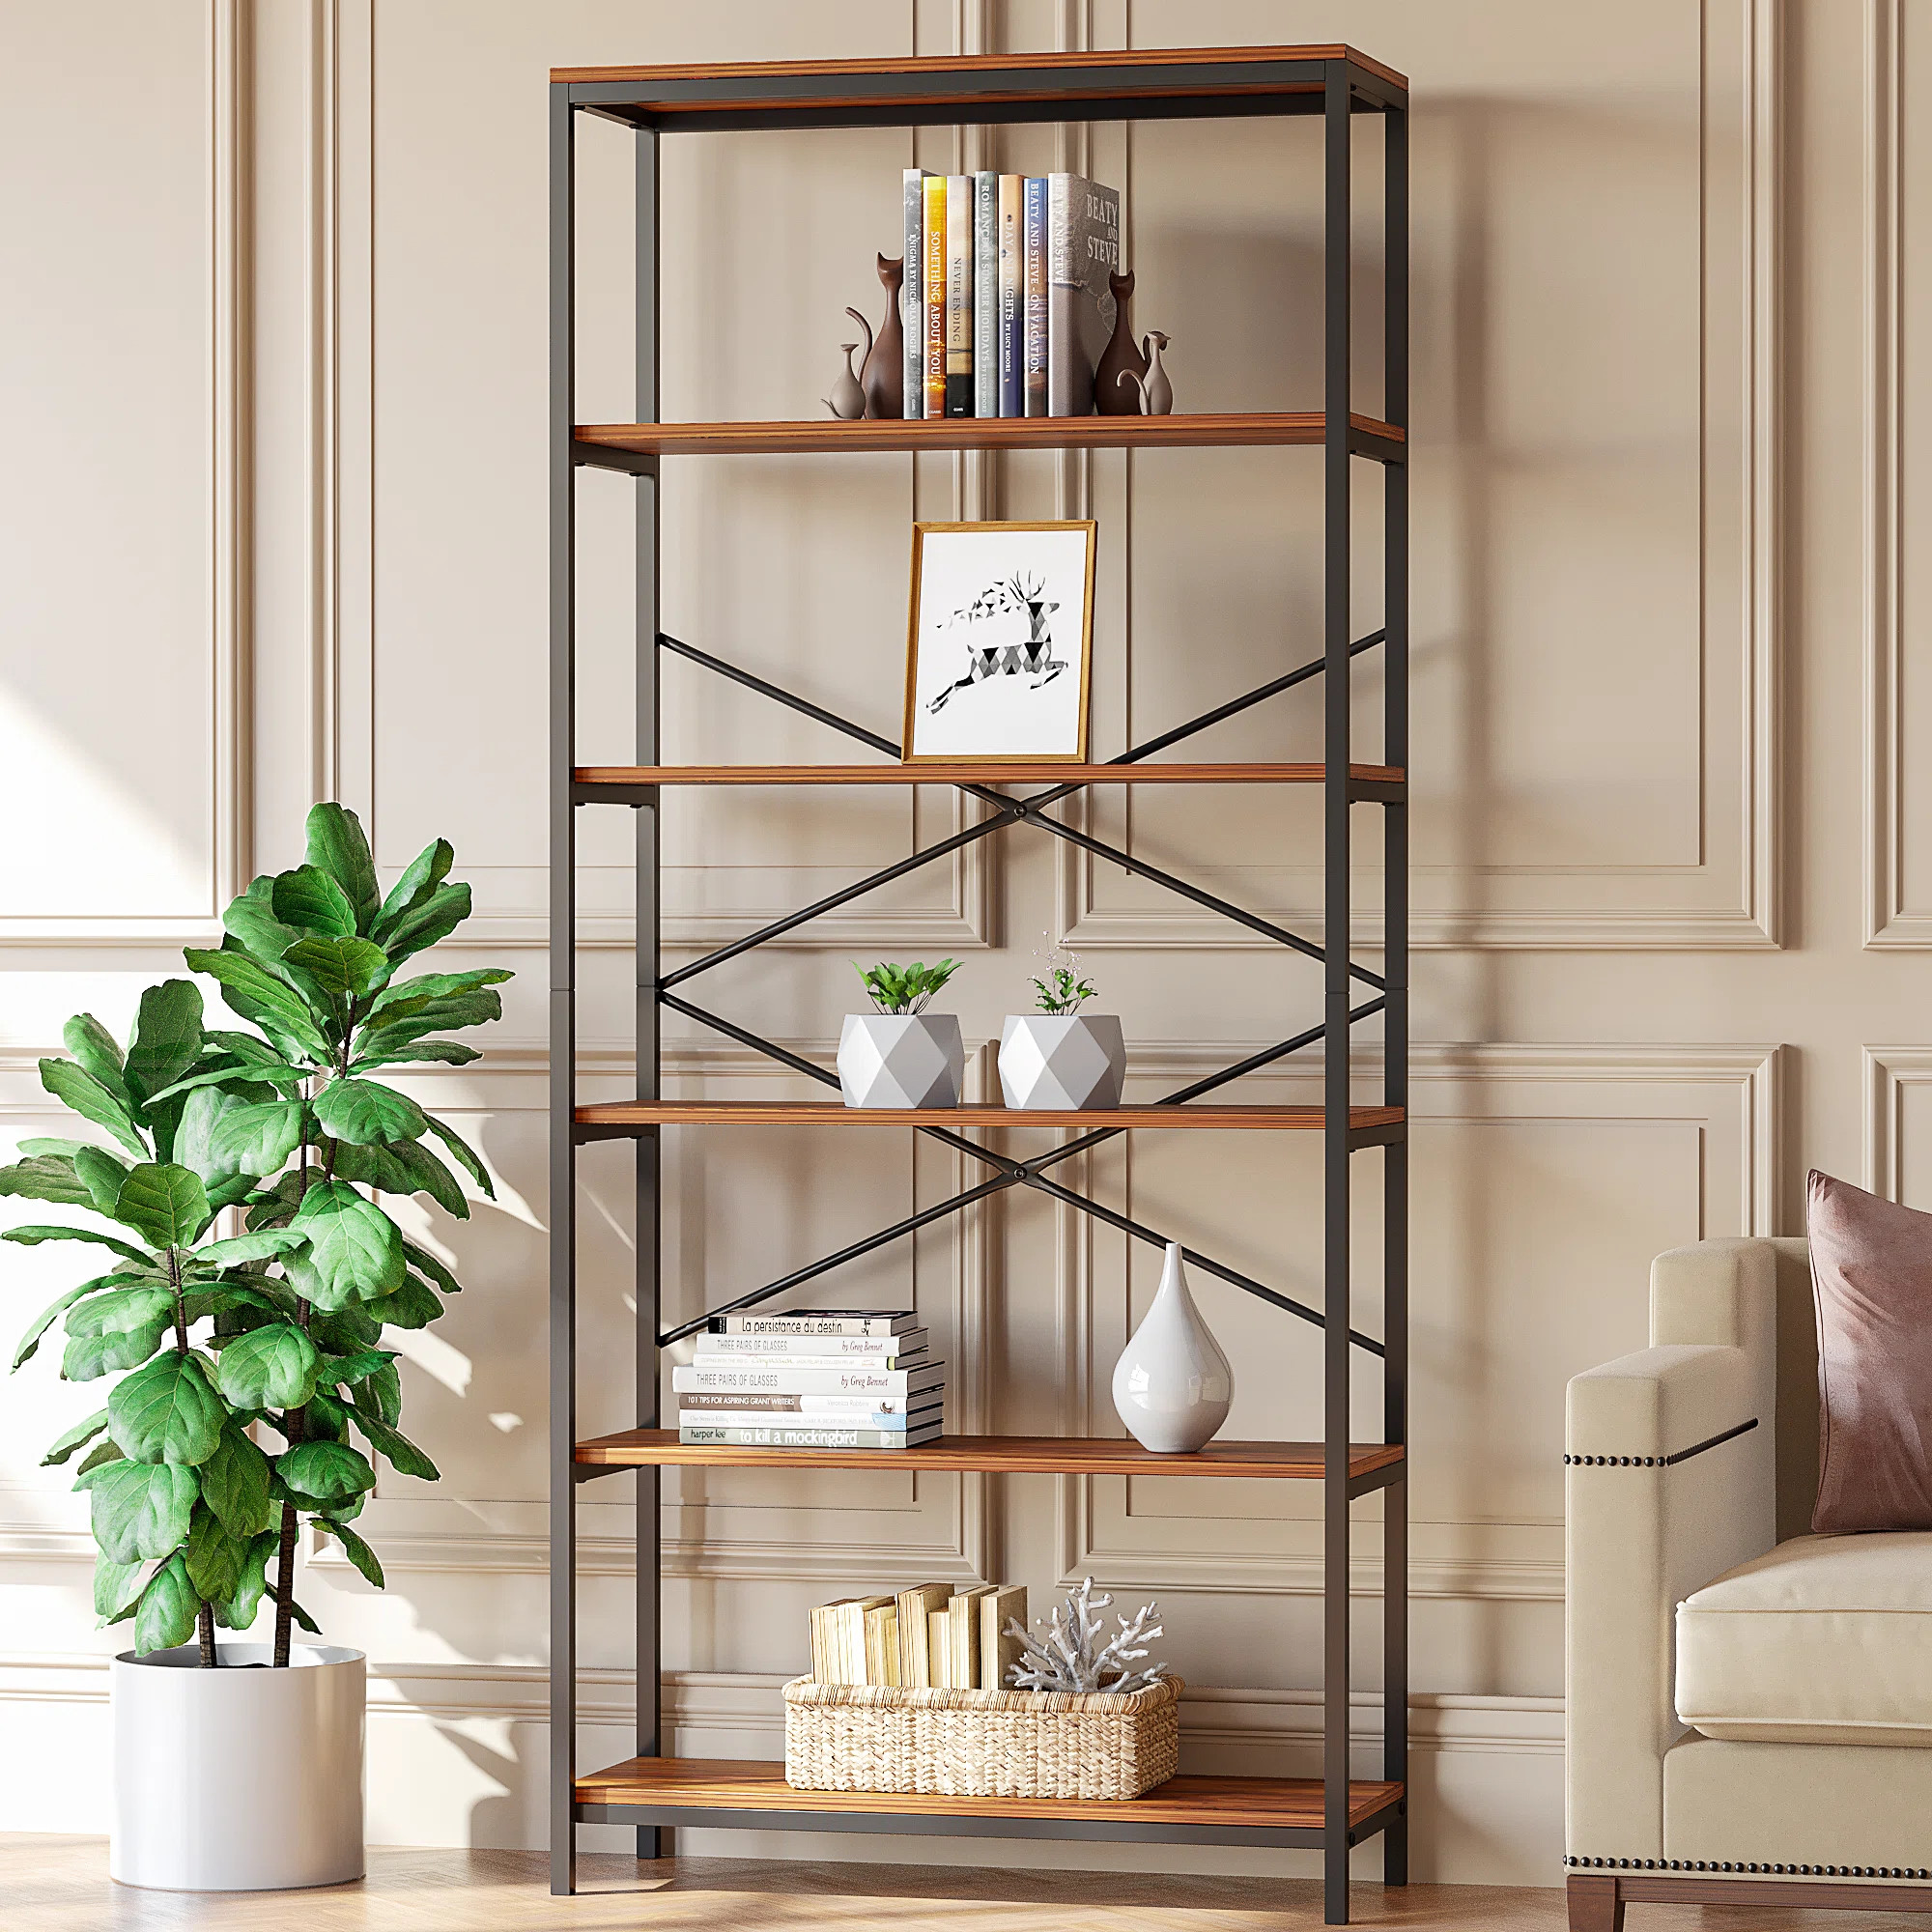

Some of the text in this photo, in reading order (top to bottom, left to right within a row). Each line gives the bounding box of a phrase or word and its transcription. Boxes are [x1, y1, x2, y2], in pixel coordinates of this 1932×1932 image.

[1030, 183, 1039, 218] BEATY
[1087, 194, 1118, 227] BEATY
[980, 185, 990, 243] ROMANCE
[1005, 221, 1014, 247] DAY
[1030, 222, 1039, 247] AND
[1055, 178, 1064, 283] BEATY AND STEVE
[1107, 226, 1118, 242] AND
[980, 245, 990, 260] ON
[1005, 249, 1014, 273] AND
[1087, 235, 1118, 266] STEVE
[909, 270, 917, 280] BY
[1030, 249, 1039, 284] STEVE
[980, 263, 990, 306] SUMMER
[930, 231, 941, 375] SOMETHING ABOUT YOU
[952, 257, 962, 342] NEVER ENDING
[1005, 277, 1014, 321] NIGHTS
[1030, 294, 1039, 311] ON
[980, 310, 990, 361] HOLIDAYS
[1005, 323, 1011, 331] BY
[1030, 314, 1039, 375] VACATION
[742, 1317, 752, 1332] La
[753, 1318, 801, 1334] persistance
[804, 1318, 814, 1333] du
[817, 1318, 842, 1333] destin
[717, 1339, 788, 1351] THREE PAIRS OF GLASSES
[841, 1341, 883, 1352] by Greg Bennet
[696, 1373, 779, 1387] THREE PAIRS OF GLASSES
[840, 1376, 889, 1389] by Greg Bennet
[691, 1429, 726, 1440] harper lee
[739, 1428, 858, 1448] to kill a mockingbird
